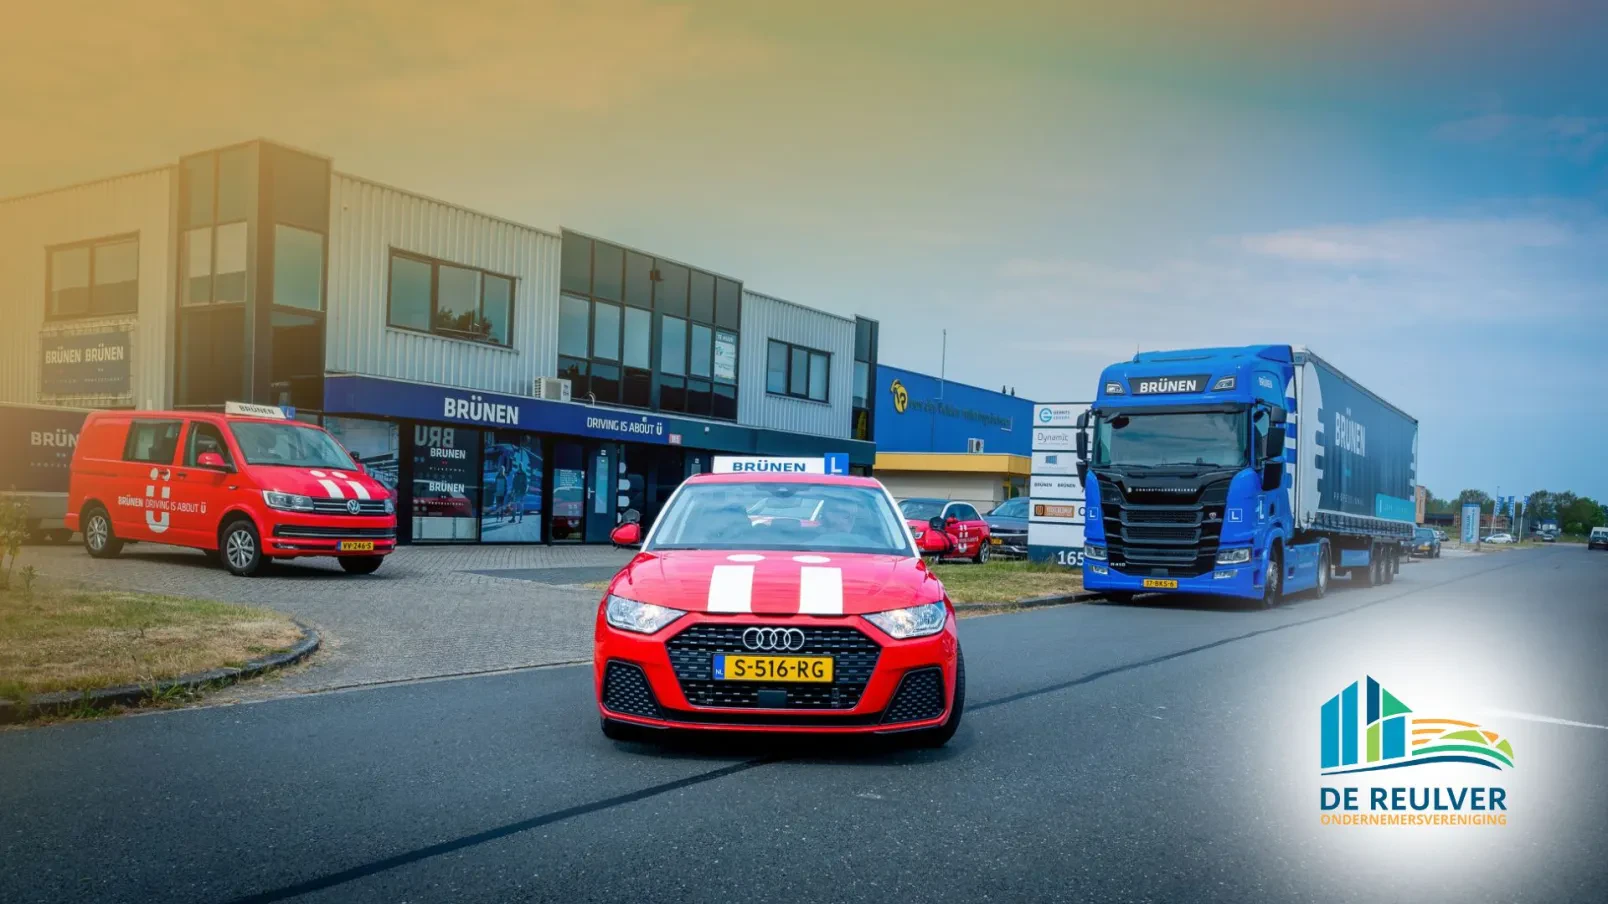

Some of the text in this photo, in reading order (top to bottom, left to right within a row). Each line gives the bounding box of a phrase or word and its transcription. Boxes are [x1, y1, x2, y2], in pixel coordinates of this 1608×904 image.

[45, 342, 124, 364] BRÜNEN BRÜNEN
[1140, 378, 1197, 393] BRÜNEN
[444, 395, 519, 425] BRÜNEN
[587, 417, 663, 436] DRIVING IS ABOUT Ü
[1335, 407, 1366, 457] BRÜNEN
[1037, 433, 1069, 442] Dynamic
[732, 459, 806, 472] BRÜNEN
[830, 456, 843, 473] L
[429, 480, 465, 493] BRÜNEN
[118, 494, 207, 514] BRÜNEN DRIVING IS ABOUT Ü
[1231, 511, 1239, 520] L
[1058, 550, 1085, 566] 165
[734, 659, 824, 678] S-516-RG
